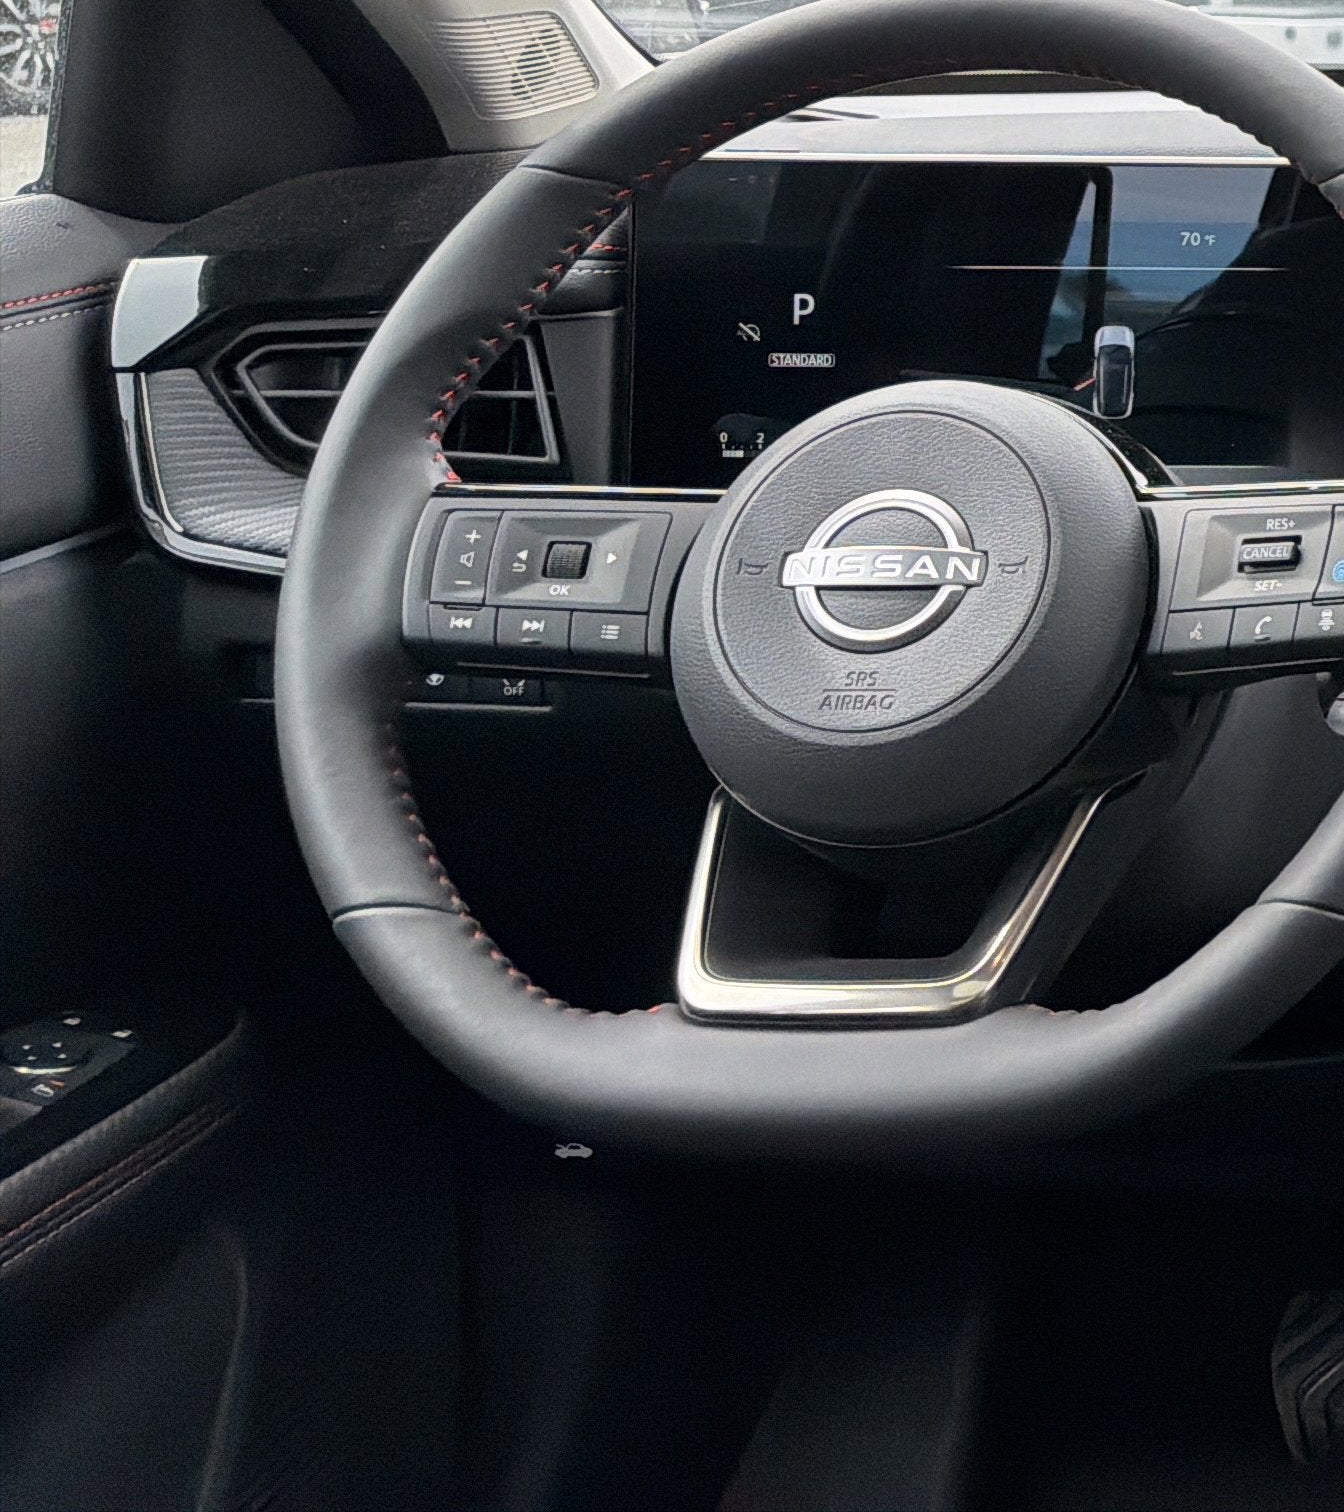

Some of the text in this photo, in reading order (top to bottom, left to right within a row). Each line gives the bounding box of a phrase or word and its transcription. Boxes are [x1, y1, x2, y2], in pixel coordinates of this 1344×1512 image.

[1180, 231, 1201, 246] 70
[793, 293, 815, 325] P
[771, 354, 832, 366] STANDARD
[719, 432, 728, 443] 0
[756, 432, 765, 444] 2
[1243, 546, 1291, 560] CANCEL
[789, 554, 982, 581] NISSAN
[548, 584, 571, 596] OK
[844, 670, 880, 687] SRS
[503, 686, 525, 696] OFF
[818, 694, 896, 711] AIRBAG
